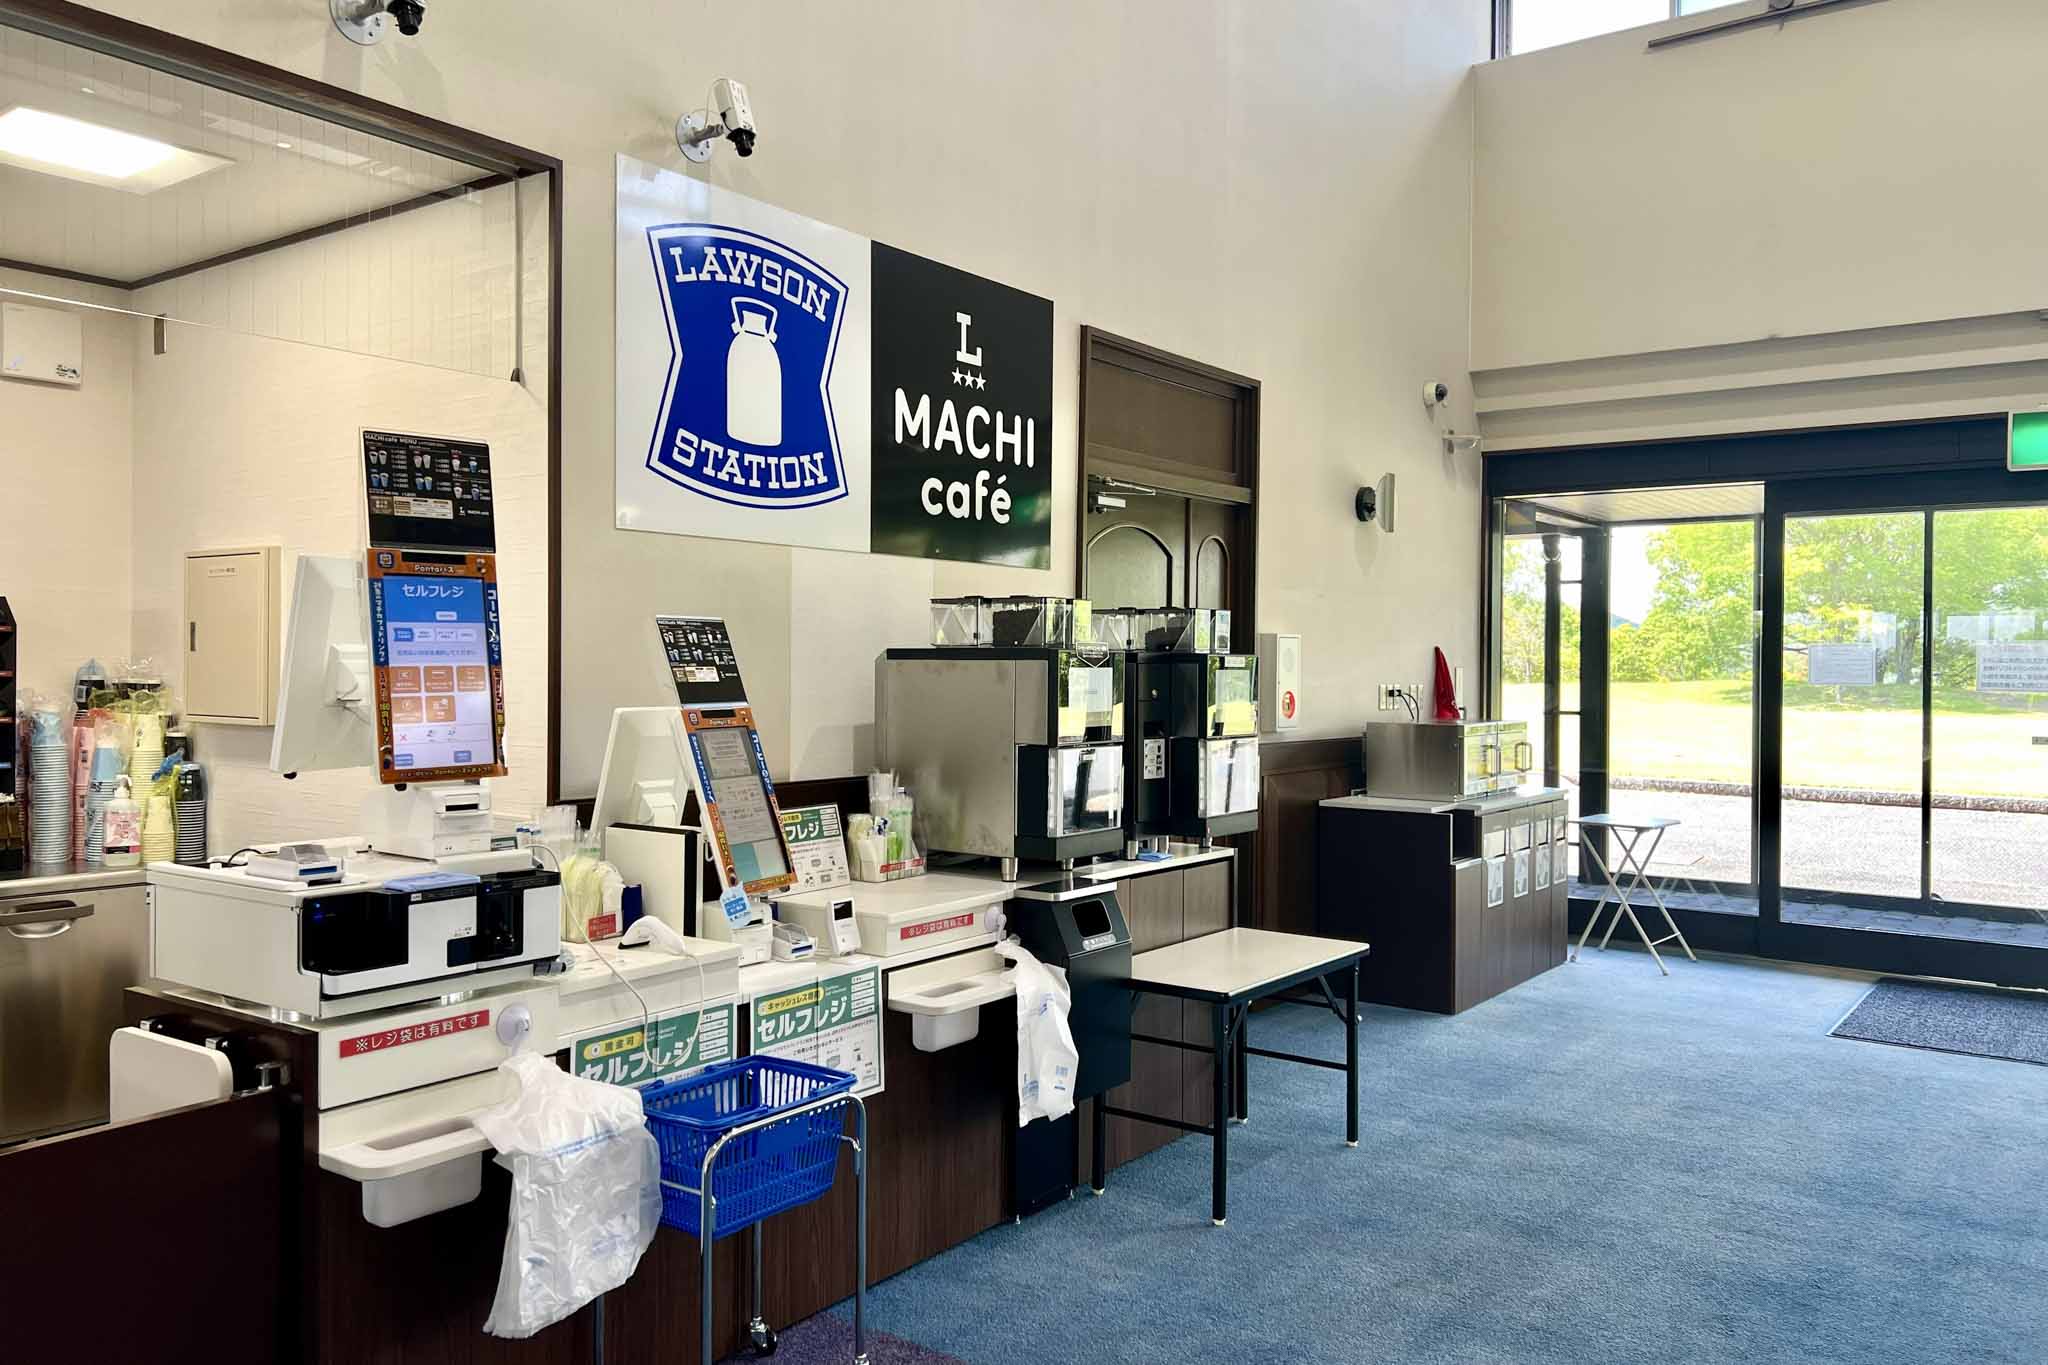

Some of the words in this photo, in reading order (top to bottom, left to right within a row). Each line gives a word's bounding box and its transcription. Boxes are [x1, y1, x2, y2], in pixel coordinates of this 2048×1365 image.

[669, 246, 830, 322] LAWSON
[955, 311, 983, 367] L
[894, 387, 1035, 468] MACHI
[672, 427, 829, 489] STATION
[921, 469, 1012, 524] café
[401, 583, 465, 598] セルフレジ
[356, 1014, 480, 1052] ※レジ袋は有料です
[758, 996, 848, 1043] セルフレジ
[580, 1036, 696, 1083] セルフレジ
